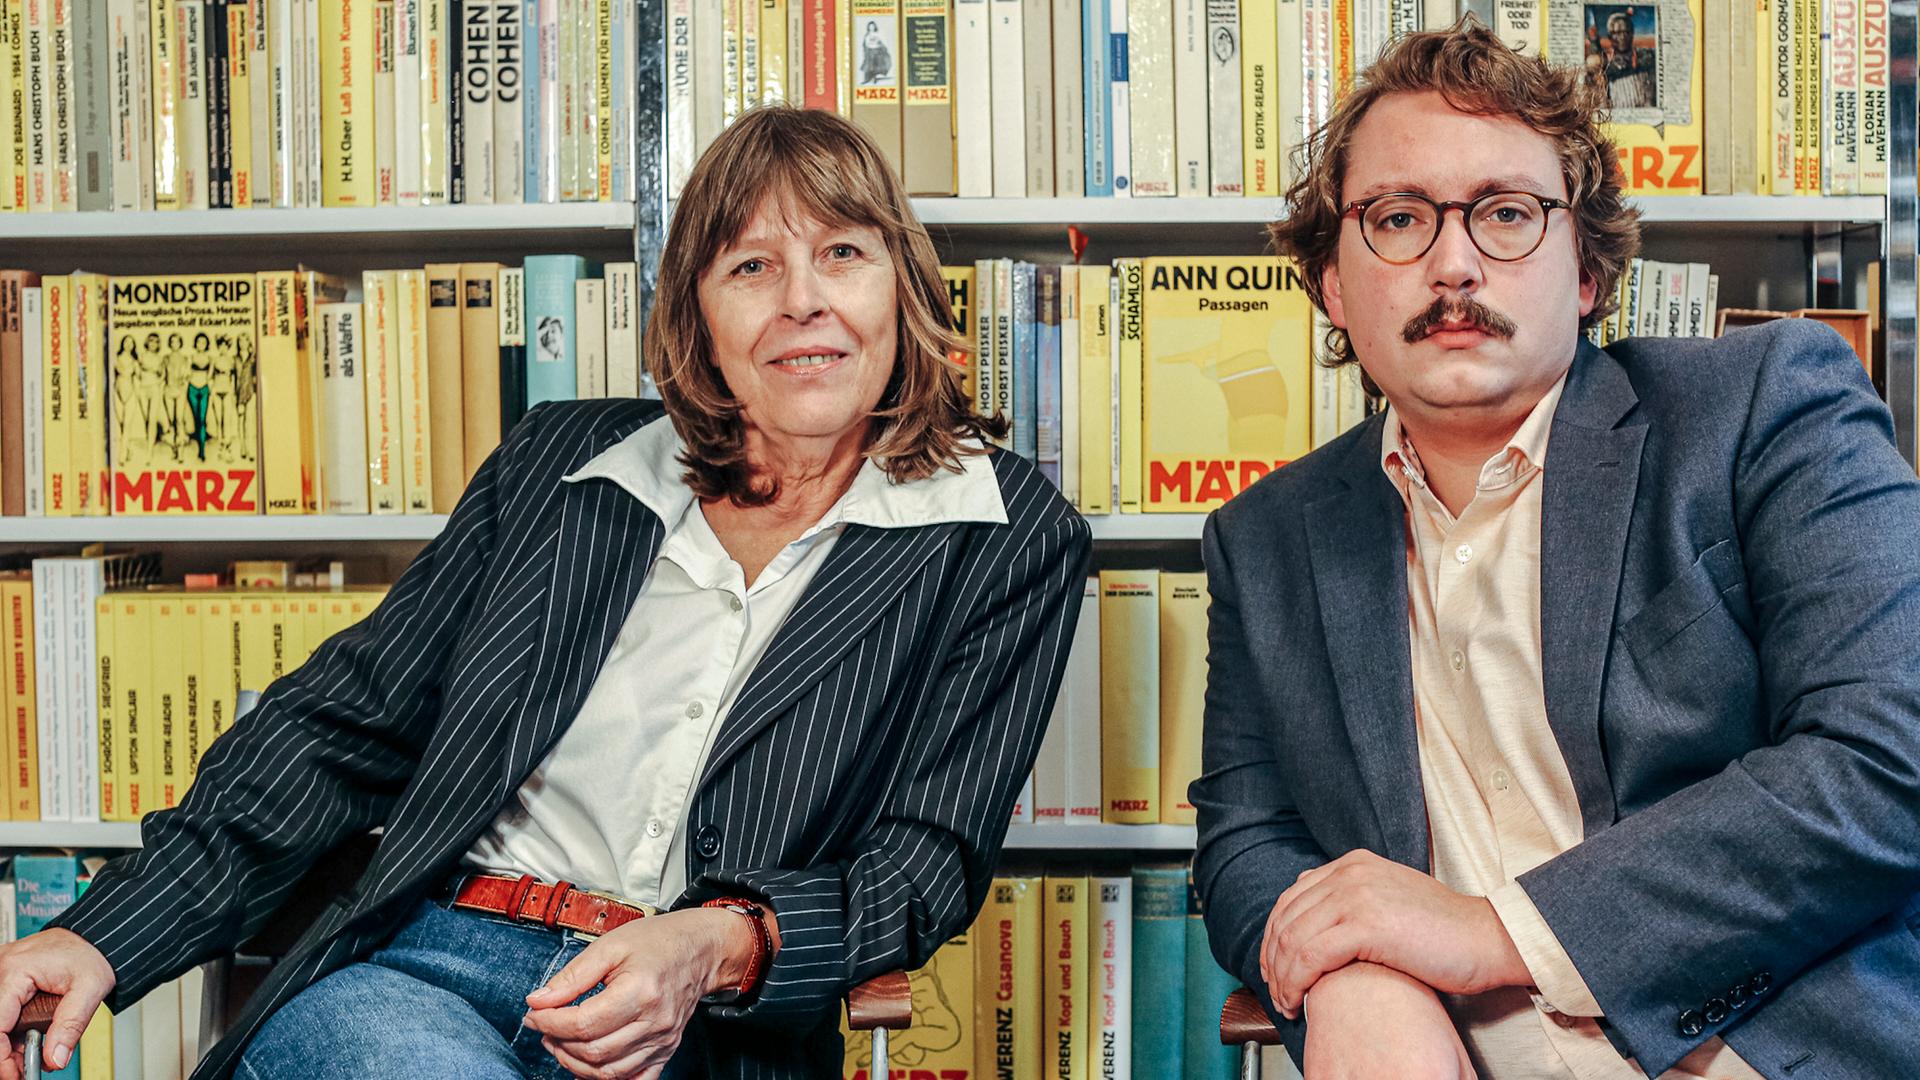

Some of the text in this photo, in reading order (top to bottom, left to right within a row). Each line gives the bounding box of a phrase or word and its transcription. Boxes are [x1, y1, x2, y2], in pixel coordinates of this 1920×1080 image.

[11, 13, 20, 51] COMICS
[187, 7, 198, 43] Kumpel
[675, 17, 688, 46] DER
[257, 33, 265, 52] Das
[467, 5, 490, 104] COHEN
[496, 4, 519, 103] COHEN
[1794, 38, 1803, 66] MACHT
[1809, 38, 1818, 66] MACHT
[597, 1, 609, 155] COHEN BLUMEN FÜR HITLER
[1777, 44, 1789, 98] DOKTOR
[1794, 69, 1803, 82] DIE
[1809, 69, 1818, 82] DIE
[30, 31, 43, 166] HANS CHRISTOPH BUCH
[55, 30, 68, 164] HANS CHRISTOPH BUCH
[340, 93, 352, 116] Laß
[856, 88, 897, 99] MÄRZ
[908, 88, 948, 99] MÄRZ
[1255, 64, 1266, 150] EROTIK-READER
[1794, 84, 1803, 116] KINDER
[1809, 84, 1818, 116] KINDER
[13, 89, 23, 144] BRAINARD
[1794, 119, 1803, 132] DIE
[1809, 119, 1818, 132] DIE
[1834, 92, 1845, 145] FLORIAN
[1845, 92, 1857, 163] HAVEMANN
[1864, 90, 1875, 144] FLORIAN
[1876, 90, 1886, 161] HAVEMANN
[340, 120, 352, 151] Claer
[1794, 134, 1803, 148] ALS
[1809, 134, 1818, 148] ALS
[14, 148, 23, 167] JOE
[1795, 157, 1804, 190] MÄRZ
[1809, 157, 1818, 191] MÄRZ
[114, 281, 251, 304] MONDSTRIP
[1151, 265, 1306, 291] ANN QUIN
[1628, 266, 1639, 287] Ehe
[113, 308, 138, 317] Neue
[140, 307, 182, 318] englische
[276, 278, 290, 317] Waffe
[1128, 265, 1141, 341] SCHAMLOS
[1199, 298, 1269, 312] Passagen
[113, 319, 156, 329] gegeben
[158, 318, 176, 327] von
[177, 318, 196, 327] Rolf
[229, 317, 252, 326] John
[1097, 304, 1106, 336] Lernen
[50, 286, 61, 421] MILBURN KINDESMORD
[338, 313, 354, 378] als Waffe
[980, 316, 990, 410] HORST PEISKER
[998, 315, 1009, 410] HORST PEISKER
[53, 473, 62, 510] MÄRZ
[114, 469, 256, 512] MÄRZ
[269, 500, 298, 509] MÄRZ
[273, 624, 282, 659] HITLER
[101, 656, 113, 774] SCHRÖDER SIEGFRIED
[128, 690, 138, 775] UPTON SINCLAIR
[163, 694, 173, 776] EROTIK-READER
[1036, 807, 1066, 817] MÄRZ
[1070, 806, 1101, 817] MÄRZ
[1110, 800, 1150, 812] MÄRZ
[18, 879, 40, 892] Die
[1058, 919, 1071, 959] Bauch
[1103, 919, 1115, 959] Bauch
[996, 919, 1013, 1001] Casanova
[1058, 964, 1071, 990] und
[1103, 964, 1115, 990] und
[1058, 994, 1073, 1027] Kopf
[1103, 994, 1117, 1027] Kopf
